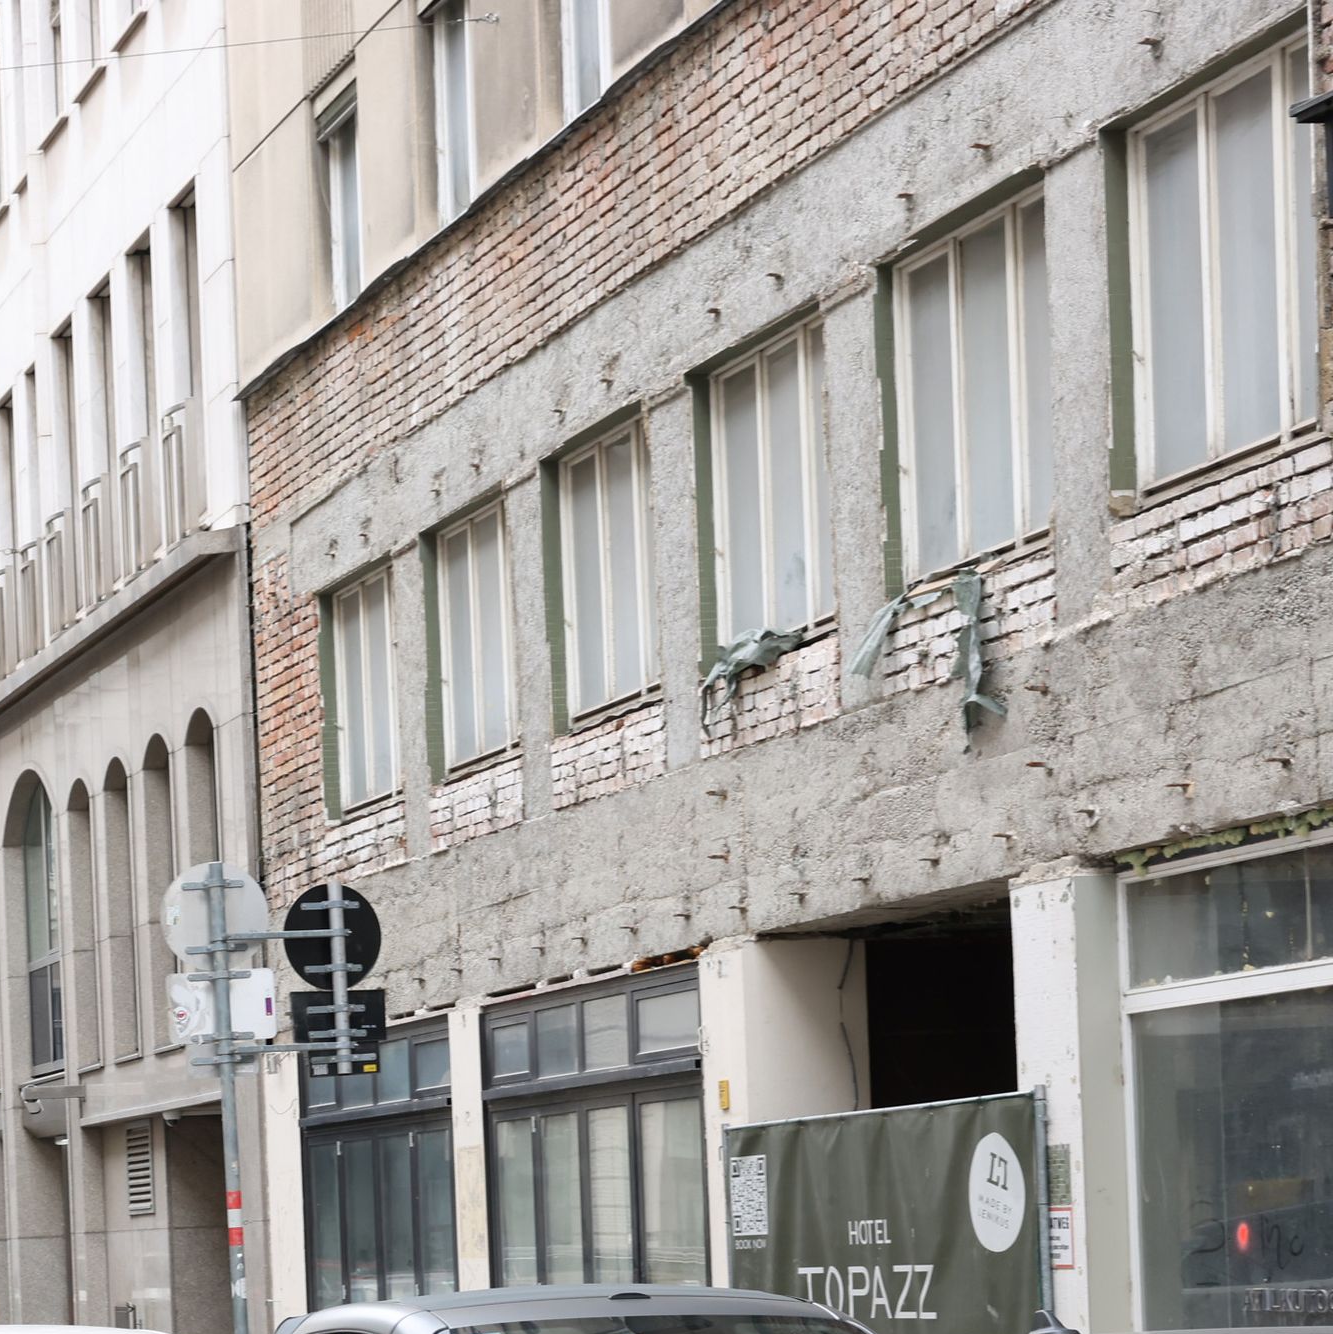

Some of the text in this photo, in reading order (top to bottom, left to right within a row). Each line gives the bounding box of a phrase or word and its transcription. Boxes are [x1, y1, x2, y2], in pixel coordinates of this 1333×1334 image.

[735, 1237, 767, 1250] BOOK NOW
[846, 1218, 892, 1246] HOTEL
[797, 1264, 938, 1320] TOPAZZ
